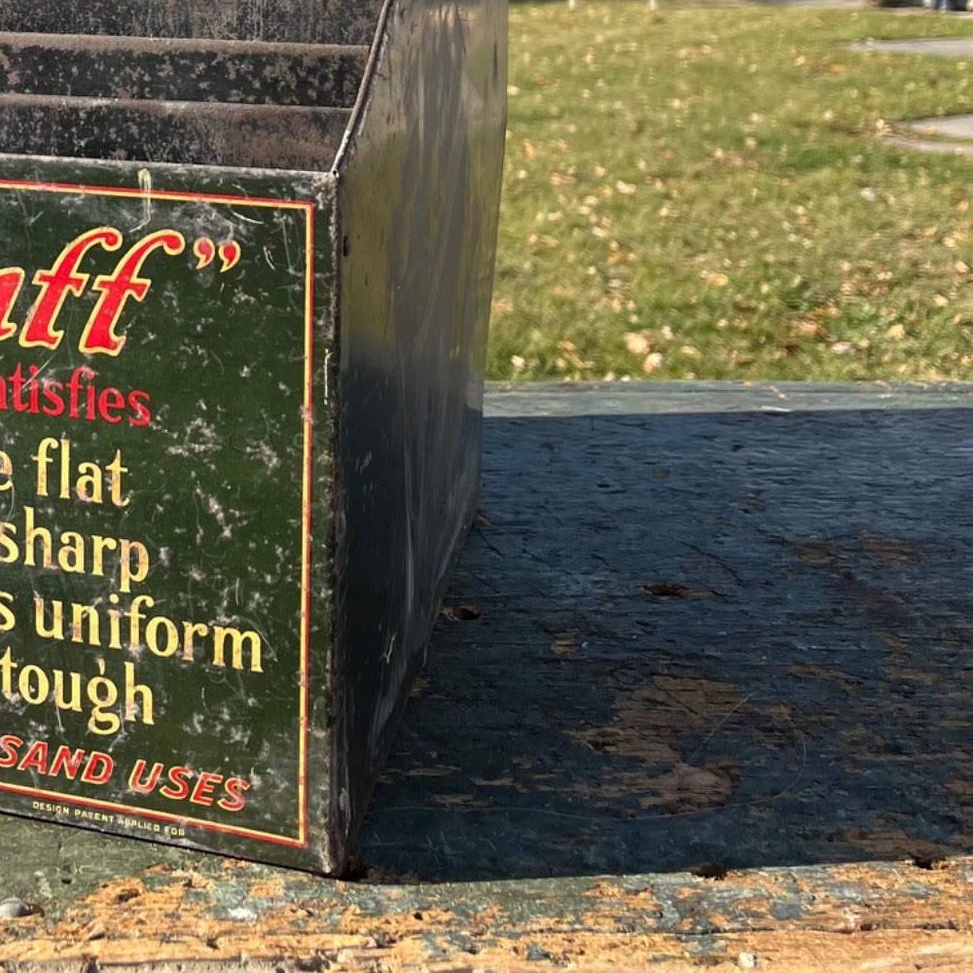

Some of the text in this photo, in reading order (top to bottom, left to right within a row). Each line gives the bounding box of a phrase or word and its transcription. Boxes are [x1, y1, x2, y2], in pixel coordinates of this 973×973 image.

[31, 436, 130, 508] flat
[32, 593, 263, 673] uniform
[127, 759, 251, 812] USES
[32, 801, 69, 815] DESIGN
[74, 809, 115, 824] PATENT
[164, 825, 186, 837] FOR
